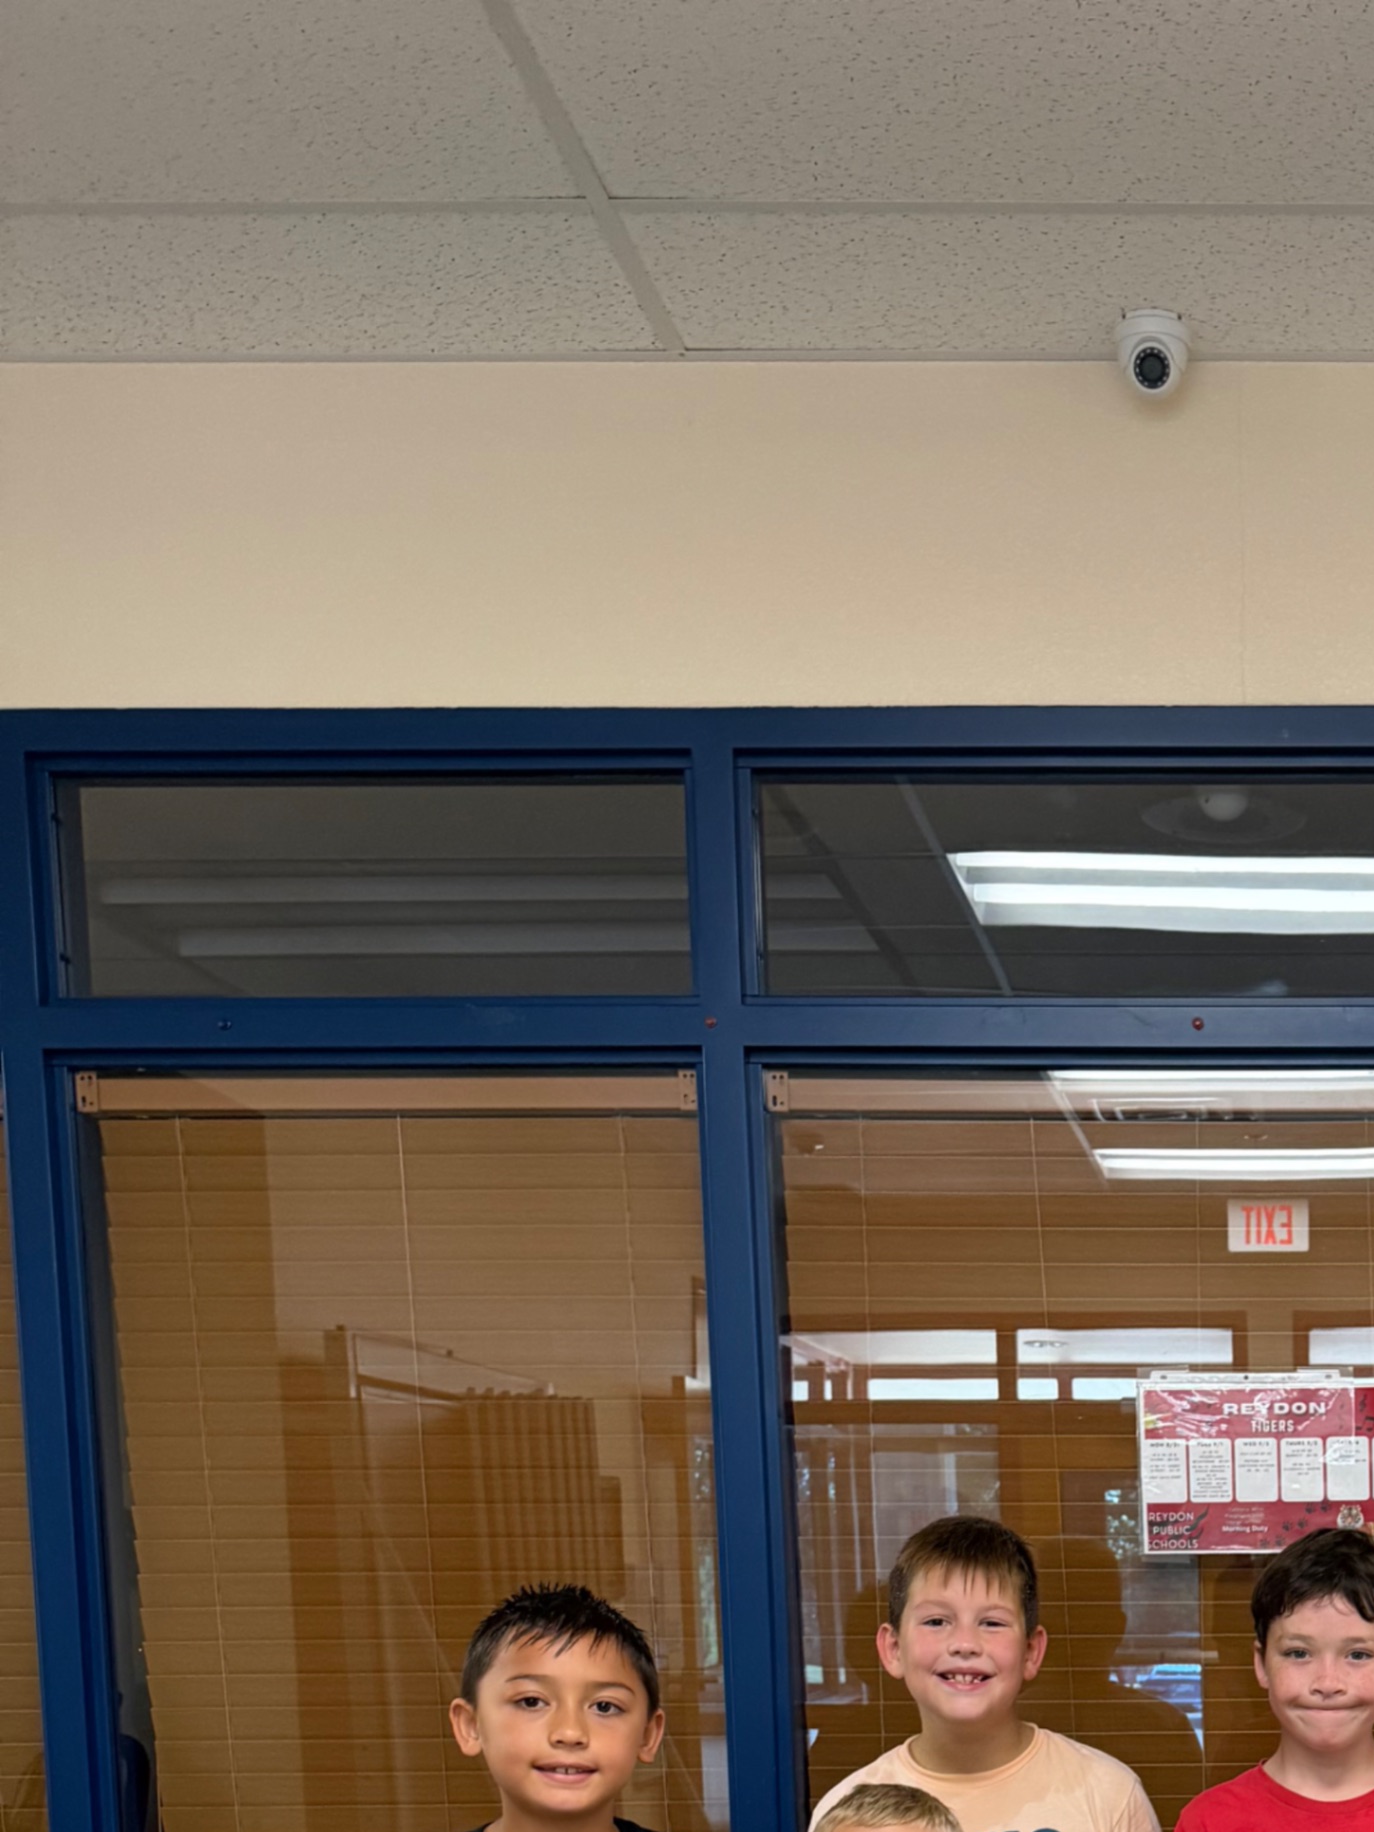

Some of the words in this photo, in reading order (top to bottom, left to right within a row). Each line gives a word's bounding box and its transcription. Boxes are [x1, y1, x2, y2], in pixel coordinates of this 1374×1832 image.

[1222, 1402, 1327, 1415] REYDON
[1251, 1420, 1295, 1433] TIGERS
[1149, 1512, 1194, 1521] REYDON
[1153, 1525, 1190, 1535] PUBLIC
